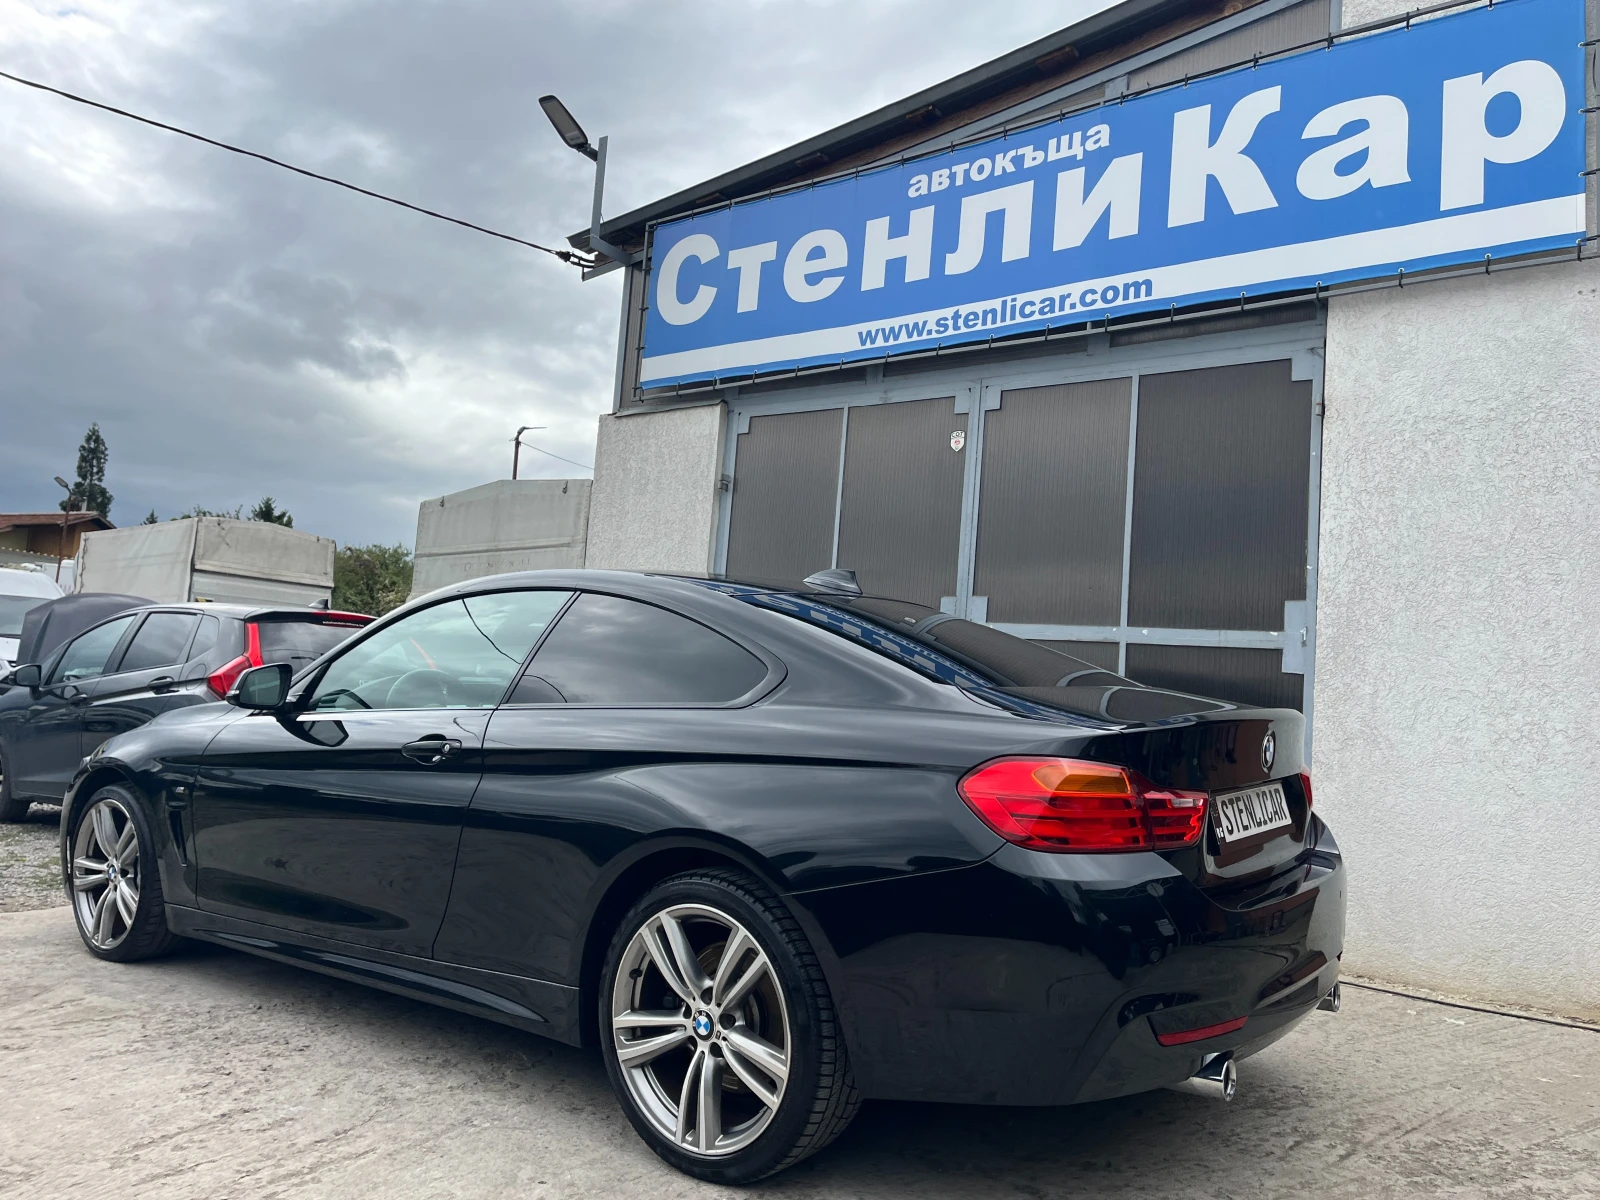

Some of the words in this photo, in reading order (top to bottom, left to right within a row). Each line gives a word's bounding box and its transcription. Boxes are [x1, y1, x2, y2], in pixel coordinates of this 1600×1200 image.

[907, 123, 1111, 198] автокъща
[858, 277, 1153, 347] www.stenlicar.com
[1220, 787, 1288, 836] STENLICAR
